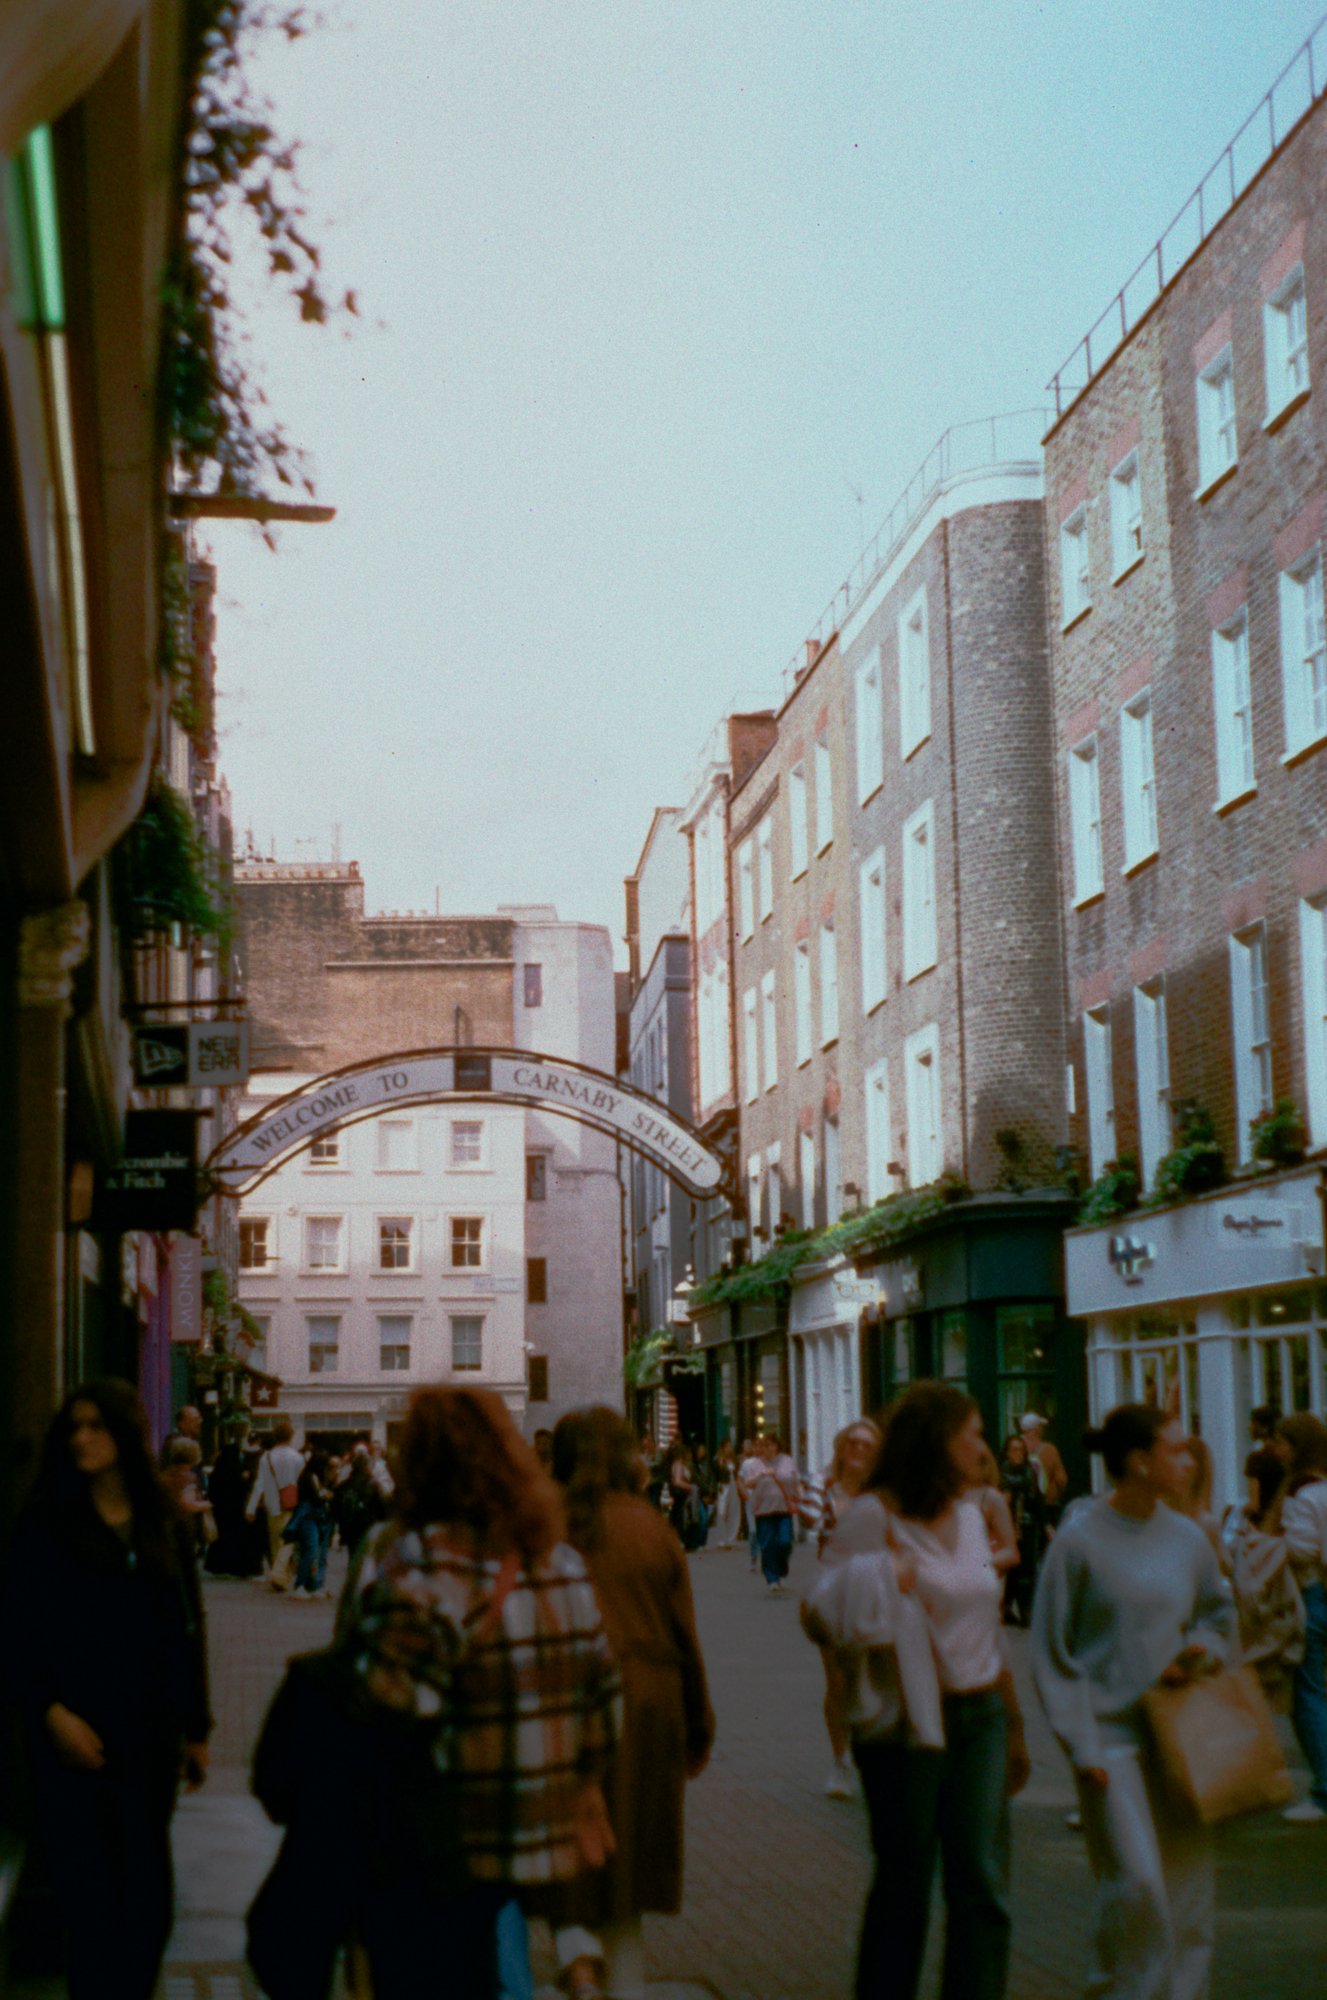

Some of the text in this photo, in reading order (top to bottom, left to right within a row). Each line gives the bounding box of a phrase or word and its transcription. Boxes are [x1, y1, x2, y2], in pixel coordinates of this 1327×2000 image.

[198, 1036, 240, 1053] NEW
[198, 1054, 240, 1073] ERA
[251, 1067, 707, 1172] WELCOME TO CARNABY STREET
[122, 1171, 167, 1190] Fitch
